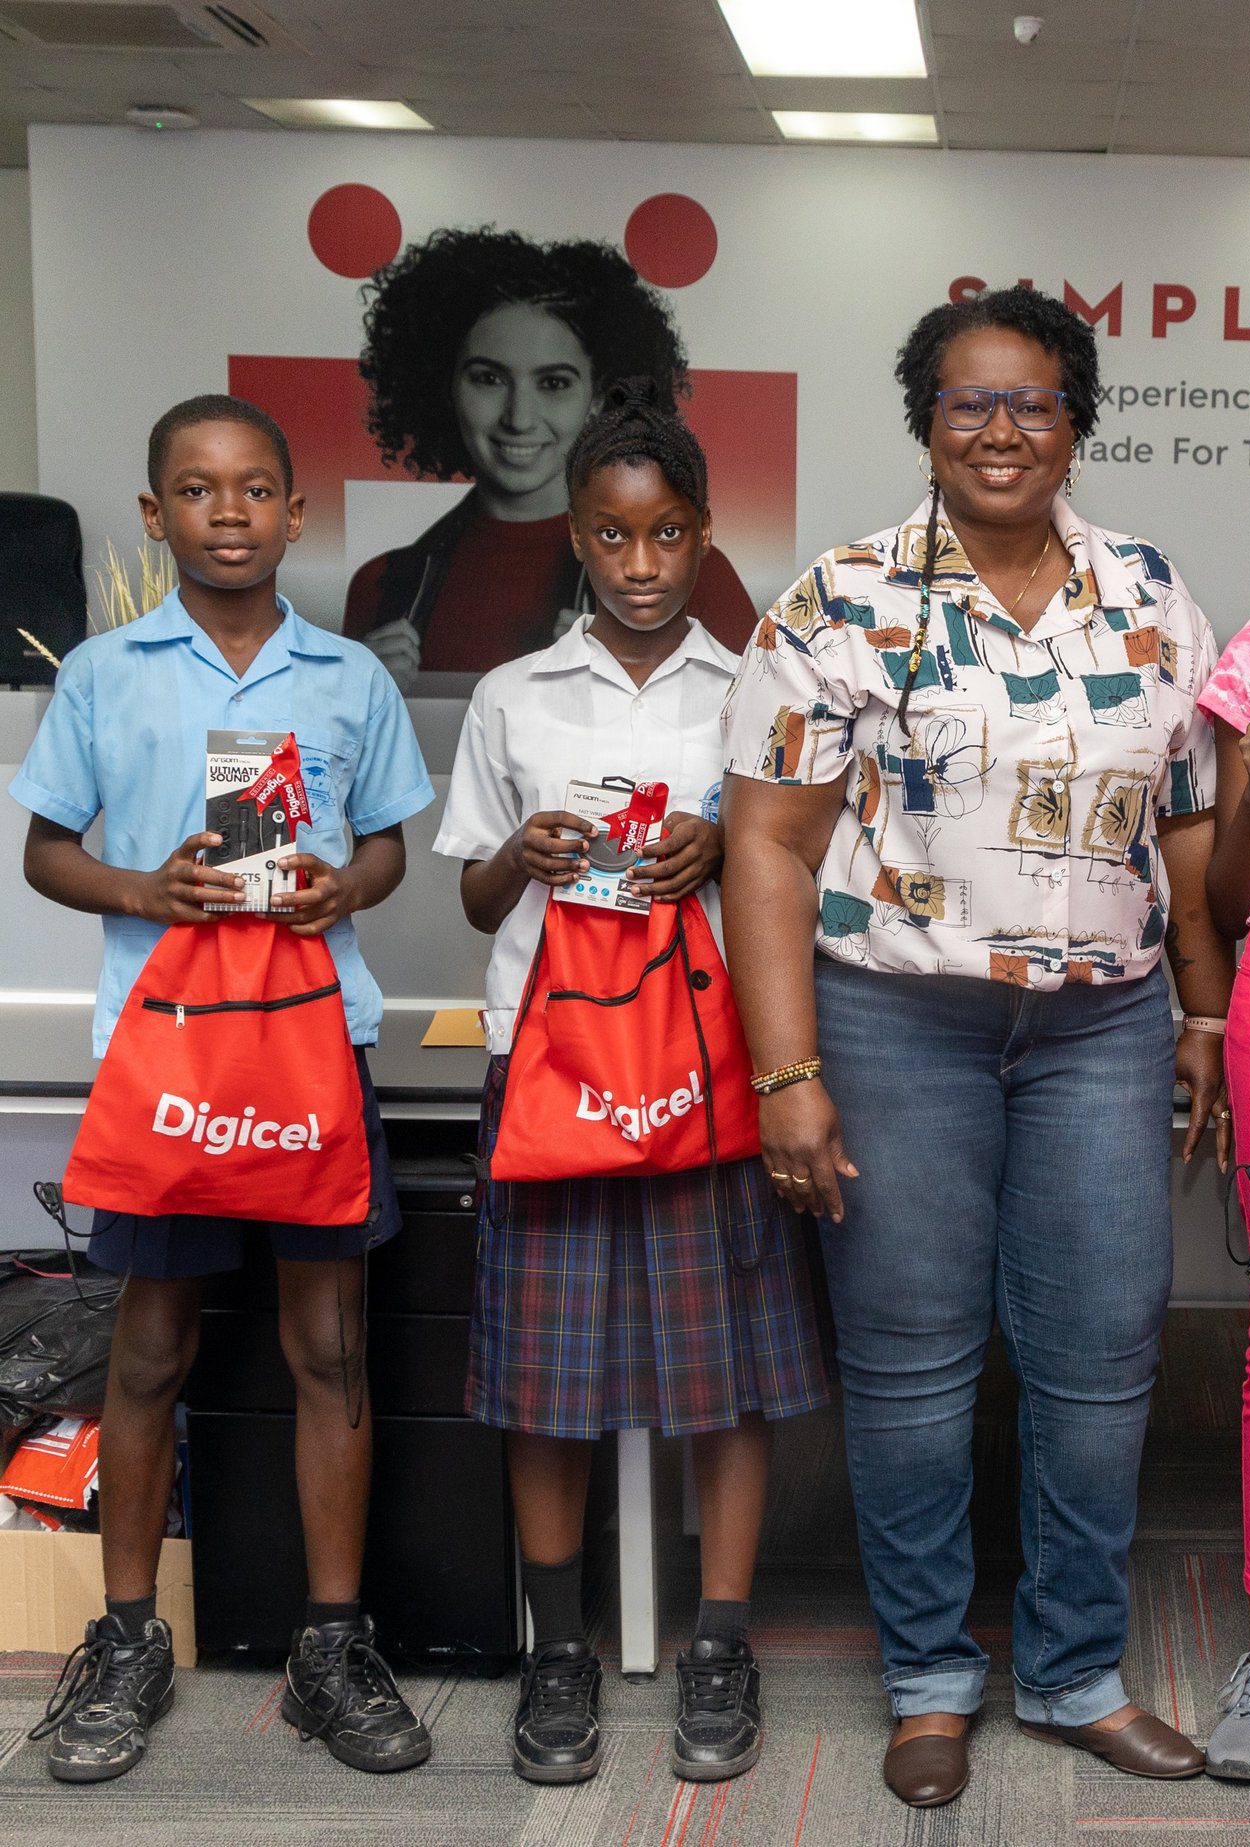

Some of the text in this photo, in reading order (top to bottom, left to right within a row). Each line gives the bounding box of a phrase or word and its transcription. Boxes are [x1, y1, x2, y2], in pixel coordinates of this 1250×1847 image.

[1173, 437, 1229, 465] For
[210, 766, 259, 776] ULTIMATE
[210, 773, 251, 783] SOUND
[257, 773, 287, 804] Digicel
[284, 783, 301, 818] Digicel
[576, 1069, 704, 1142] Digicel
[152, 1092, 322, 1155] Digicel
